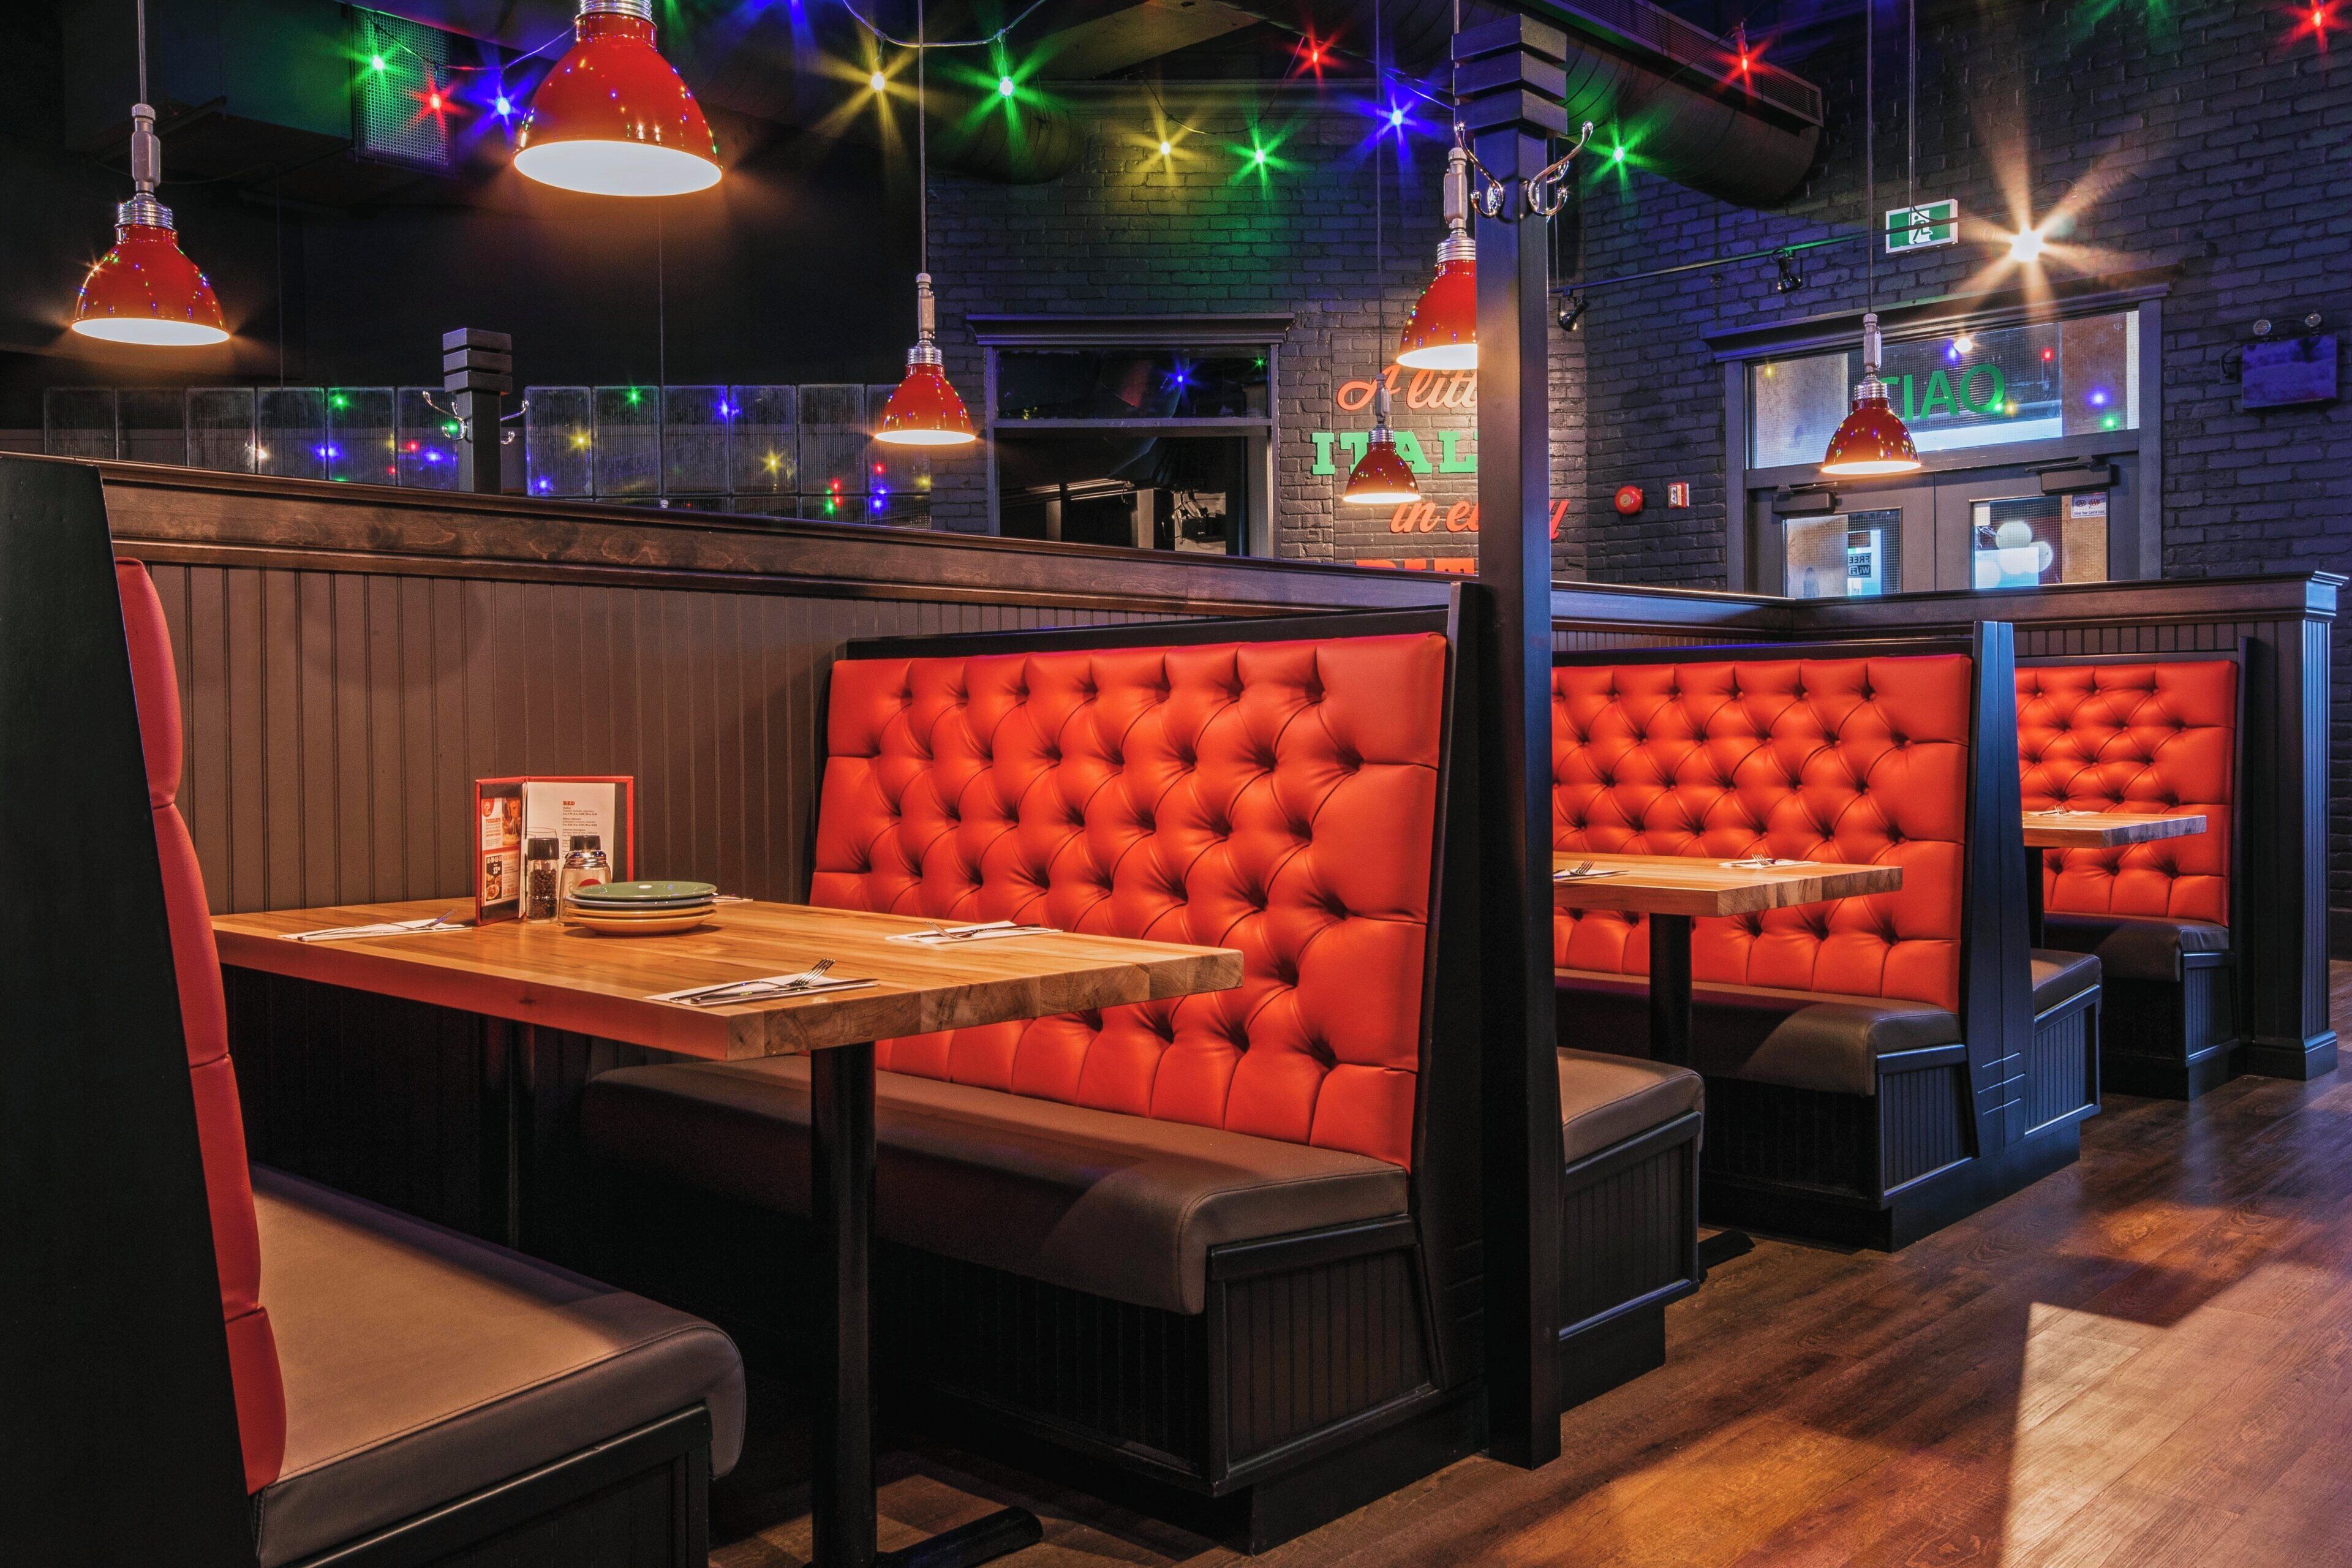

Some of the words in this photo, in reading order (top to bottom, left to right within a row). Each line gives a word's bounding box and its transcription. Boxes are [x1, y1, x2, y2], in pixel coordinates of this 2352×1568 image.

[1407, 369, 1478, 409] litt
[1879, 364, 2005, 421] IAO
[1312, 431, 1478, 475] ITAL
